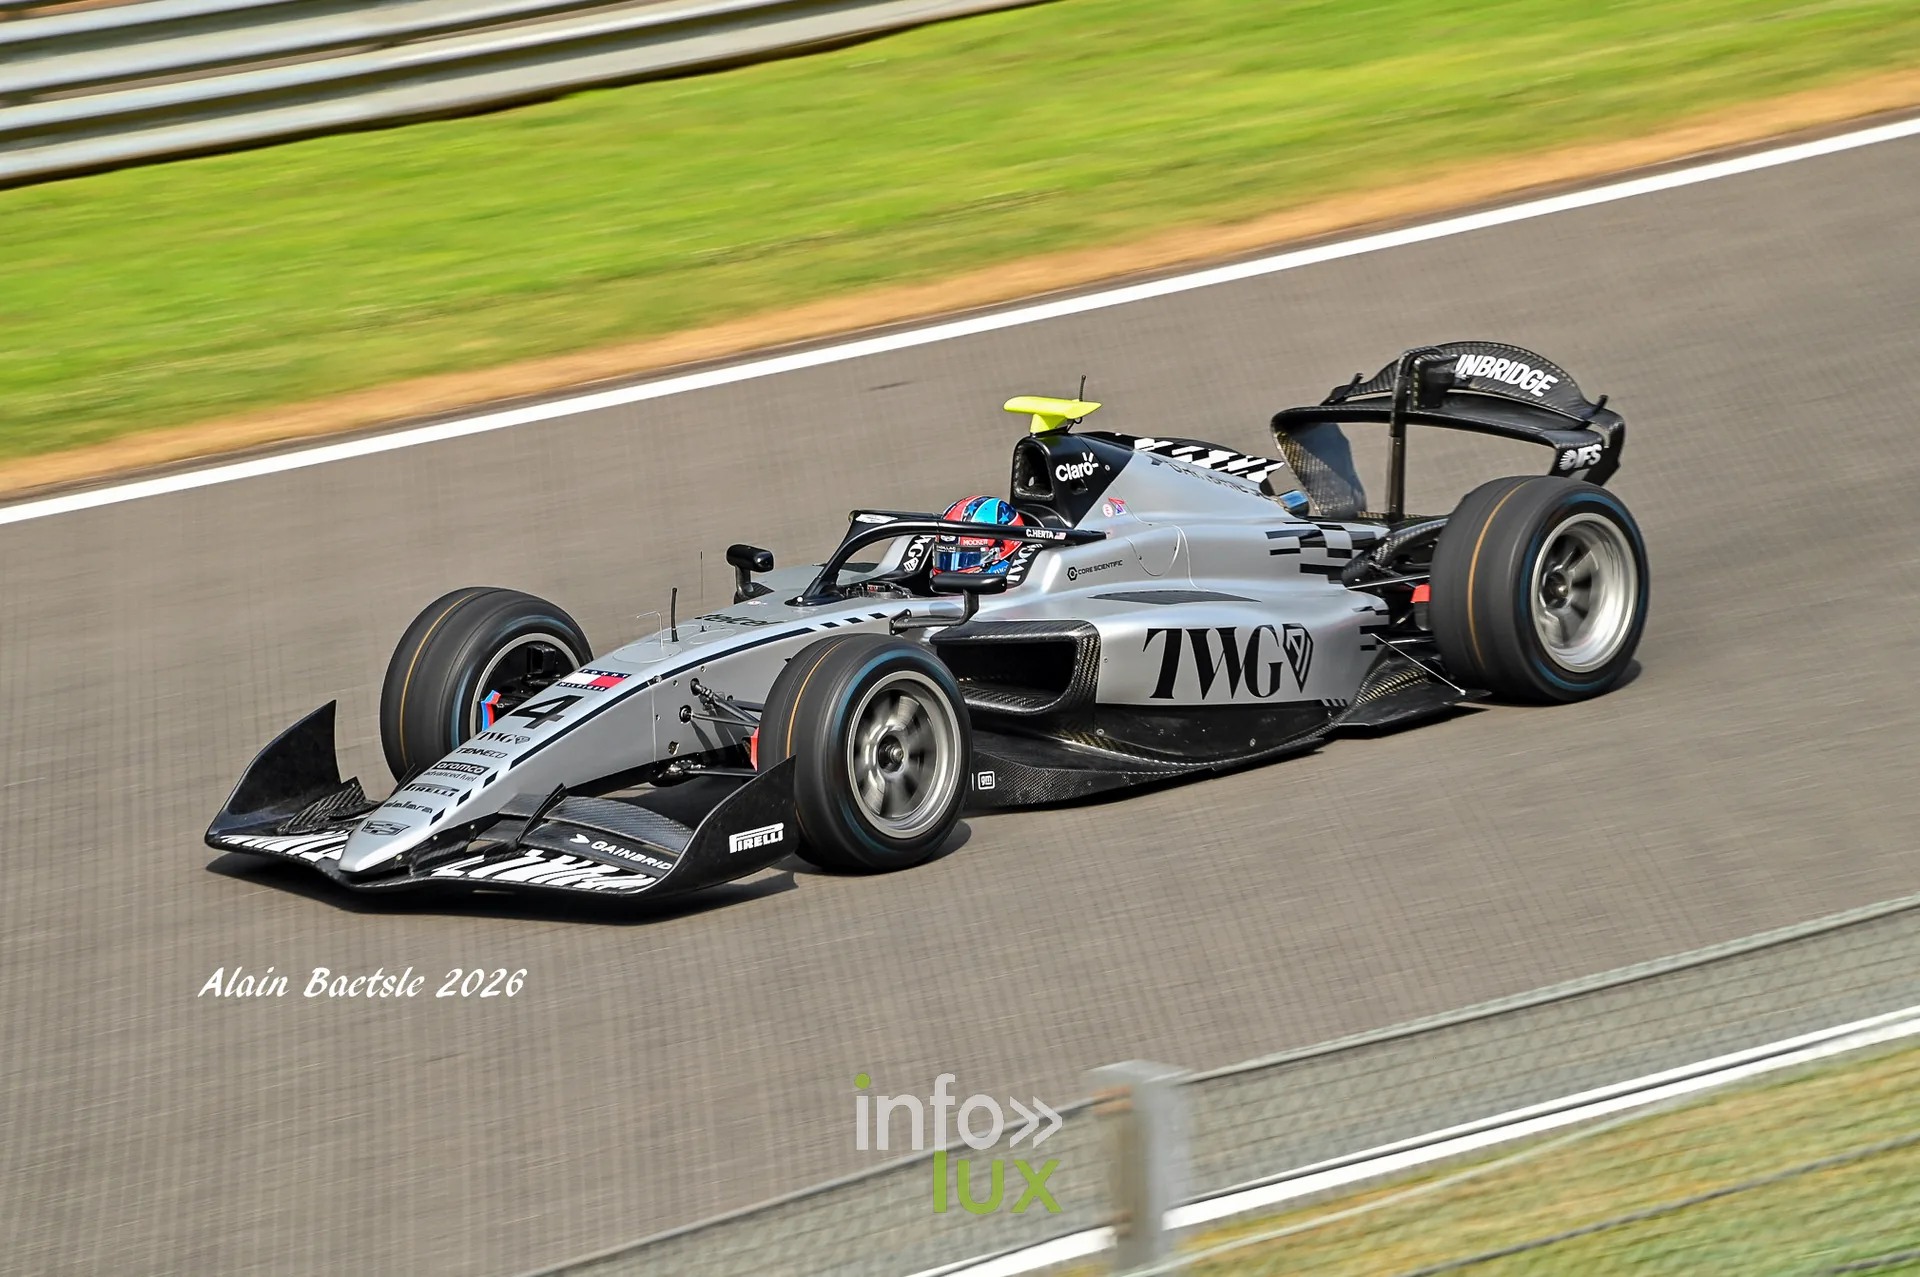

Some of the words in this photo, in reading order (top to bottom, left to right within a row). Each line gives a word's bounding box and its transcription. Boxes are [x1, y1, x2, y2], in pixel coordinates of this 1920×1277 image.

[1455, 354, 1559, 397] INBRIDGE
[1055, 454, 1097, 482] Claro
[1077, 566, 1093, 576] CORE
[1093, 559, 1124, 572] SCIENTIFIC
[1143, 624, 1283, 701] TWG
[582, 669, 629, 679] TOMMY
[508, 694, 585, 730] 4
[456, 747, 508, 759] TENNECO
[437, 761, 484, 774] aramco
[459, 772, 478, 783] fuel
[402, 783, 460, 797] PIRELLI
[729, 822, 784, 853] PIRELLI
[591, 840, 673, 870] GAINBRID
